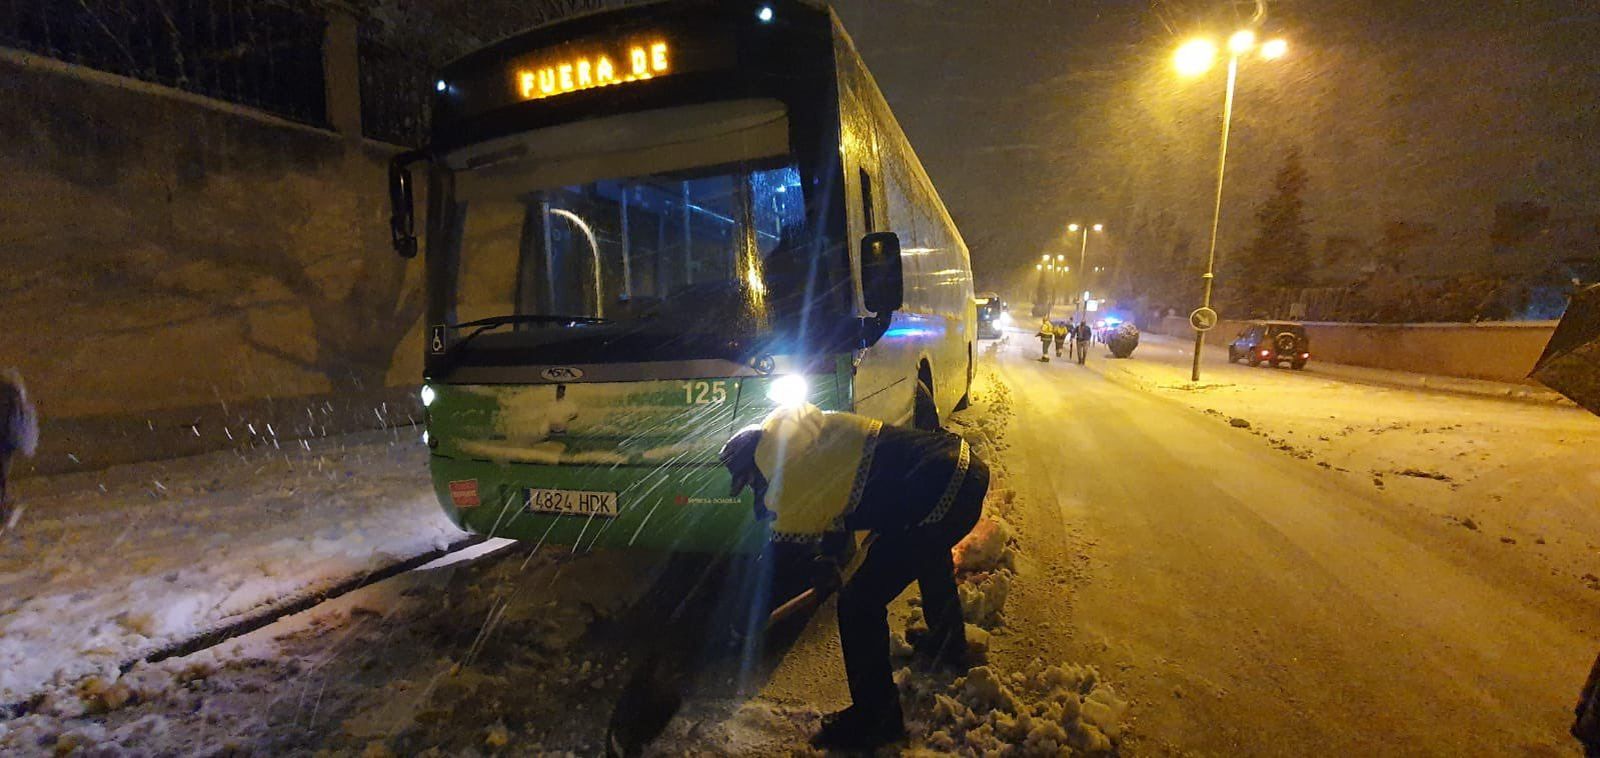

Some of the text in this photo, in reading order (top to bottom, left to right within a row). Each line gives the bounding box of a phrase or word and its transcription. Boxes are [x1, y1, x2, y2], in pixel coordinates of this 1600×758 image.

[519, 42, 668, 98] FUERA DE
[682, 381, 727, 405] 125
[535, 491, 611, 513] 4824 HDK
